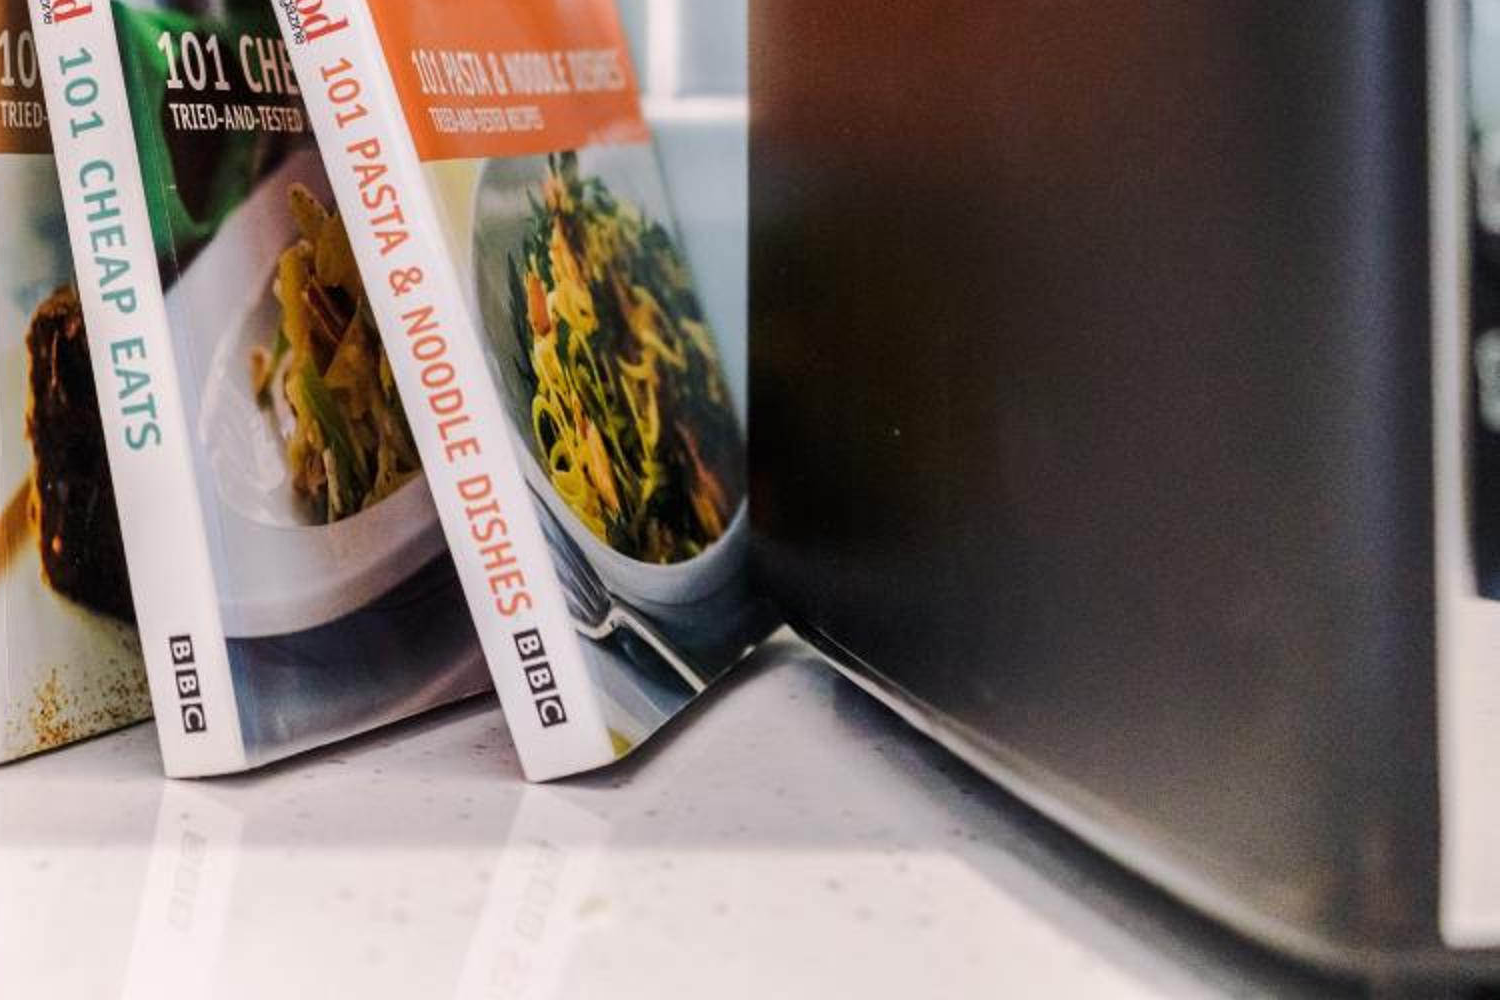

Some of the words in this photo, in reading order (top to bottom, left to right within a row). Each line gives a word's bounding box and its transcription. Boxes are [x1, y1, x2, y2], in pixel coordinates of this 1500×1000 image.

[59, 47, 104, 138] 101
[158, 31, 232, 92] 101
[239, 36, 299, 95] CHE
[321, 57, 367, 130] 101
[169, 103, 304, 133] TRIED-AND-TESTED
[79, 160, 140, 316] CHEAP
[347, 138, 409, 255] PASTA
[389, 266, 423, 295] &
[109, 335, 162, 452] EATS
[401, 305, 482, 462] NOODLE
[456, 474, 534, 619] DISHES
[169, 635, 207, 735] BBC
[513, 628, 566, 728] BBC
